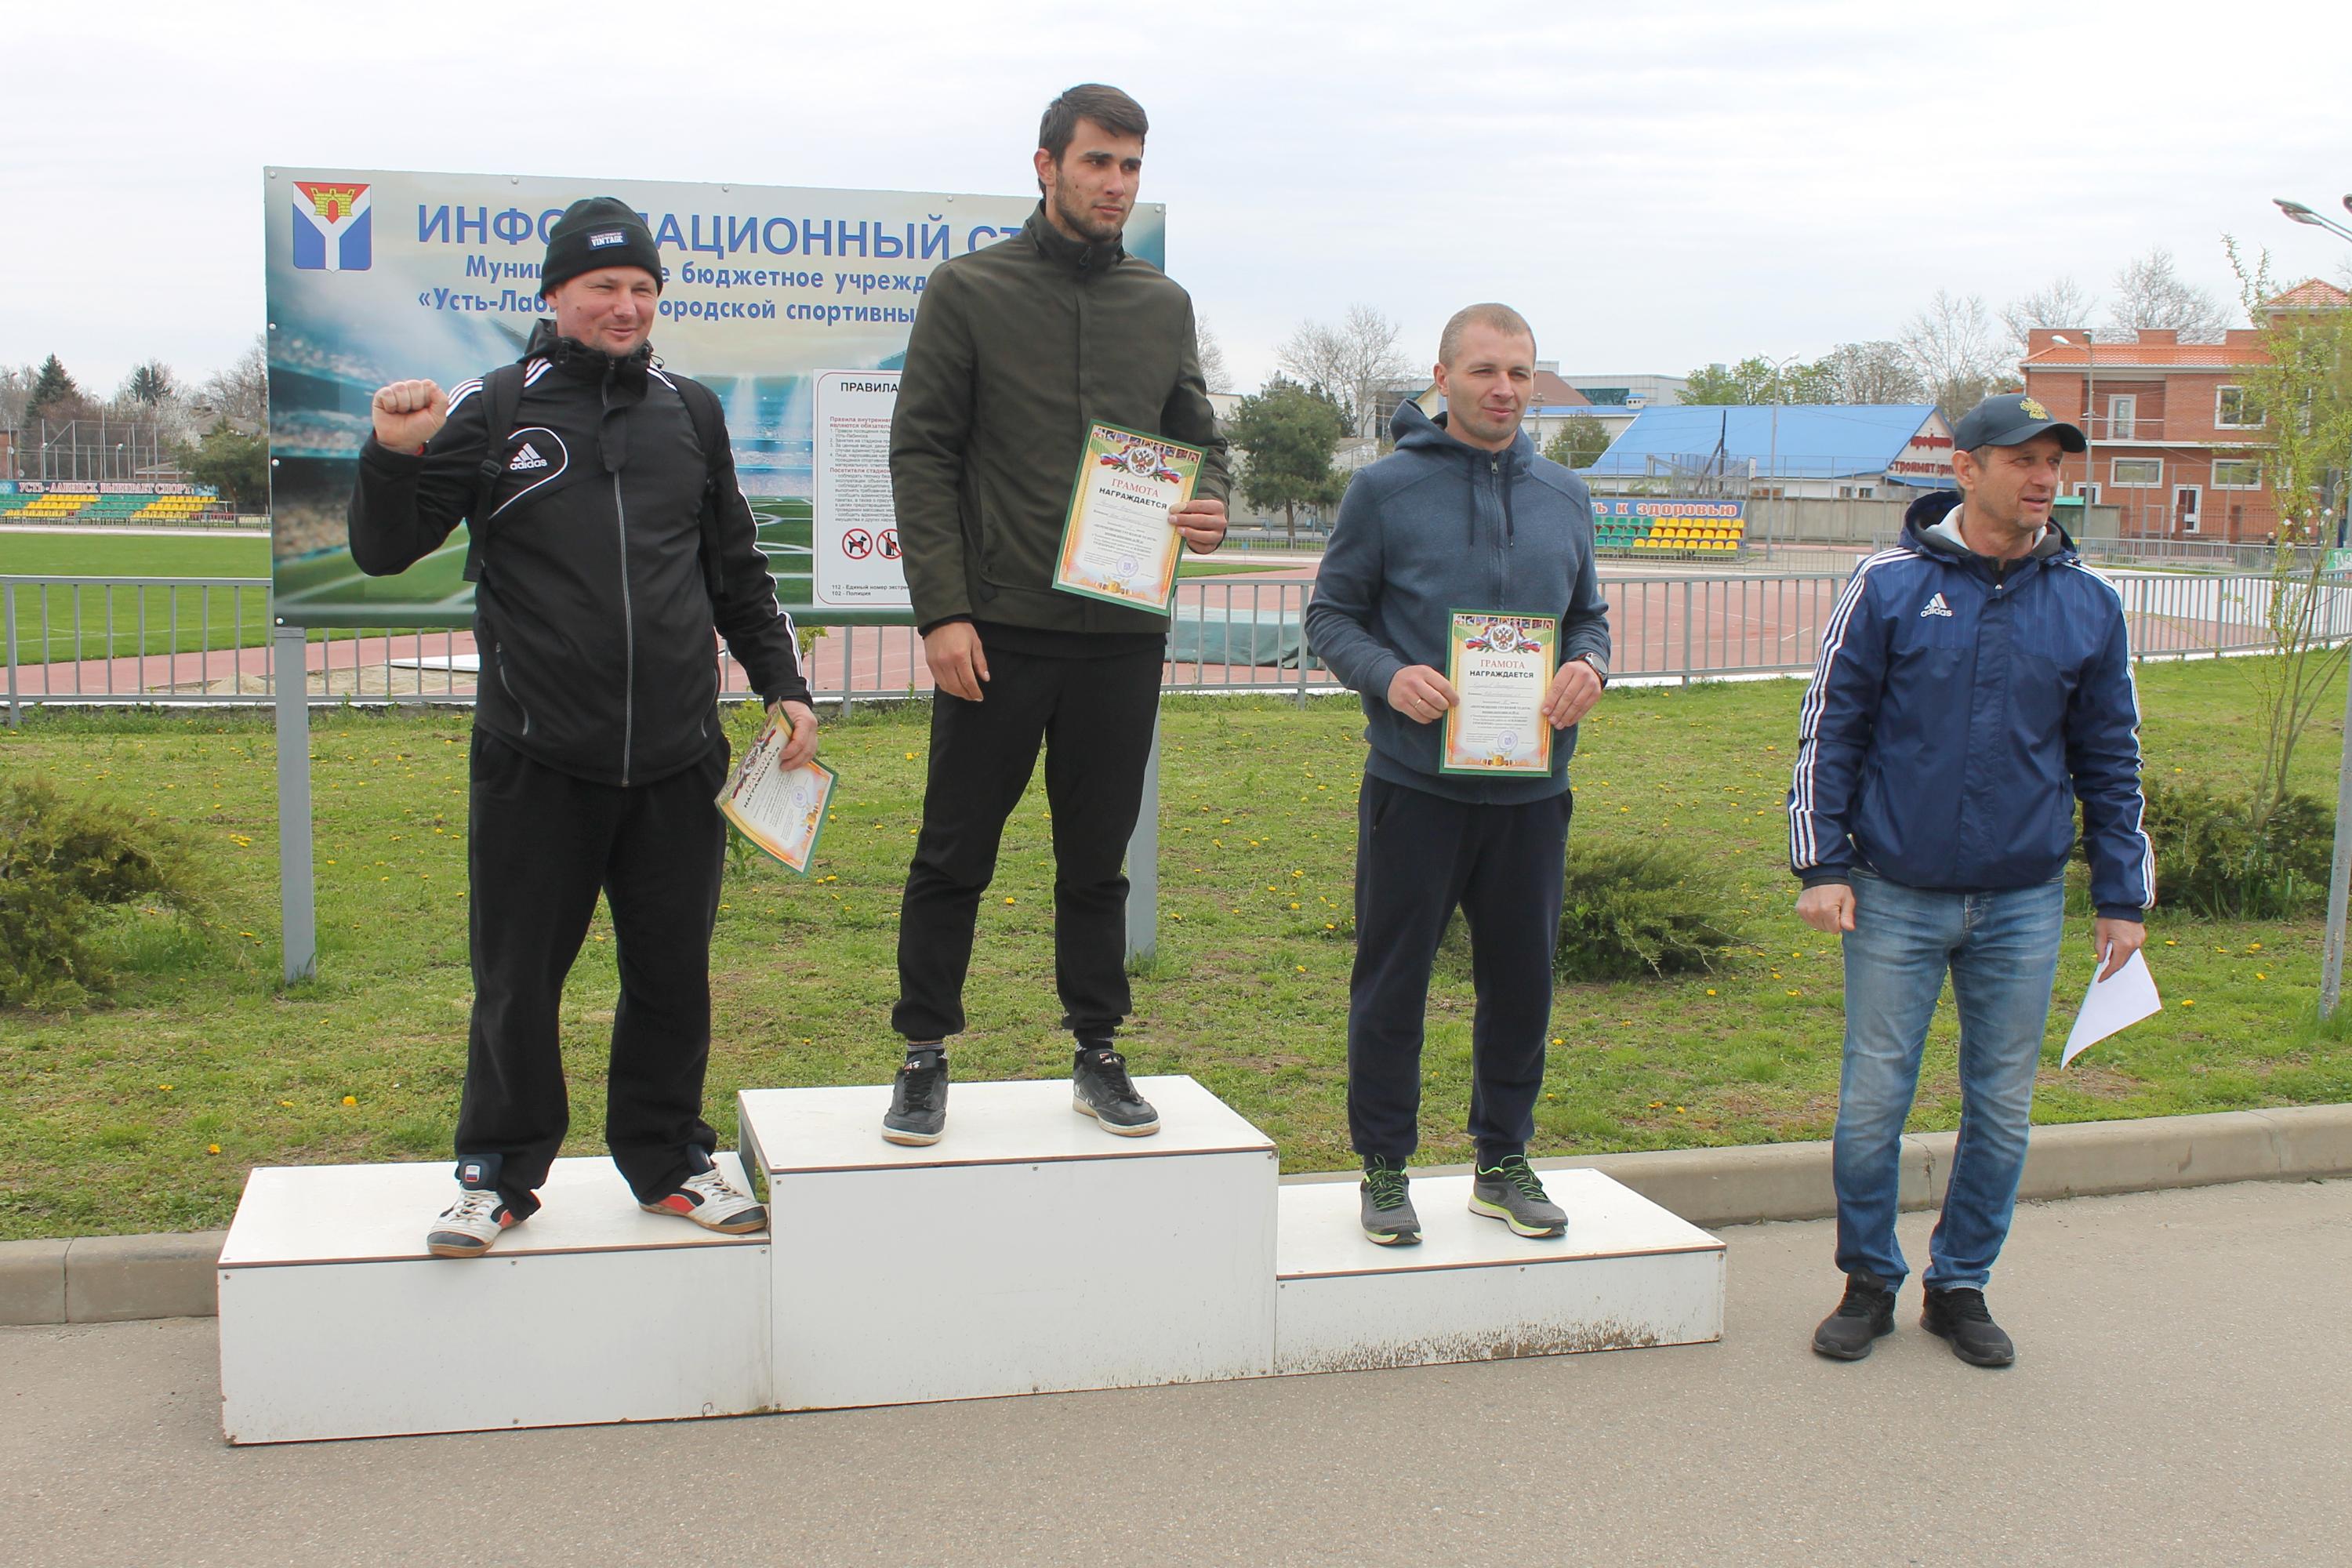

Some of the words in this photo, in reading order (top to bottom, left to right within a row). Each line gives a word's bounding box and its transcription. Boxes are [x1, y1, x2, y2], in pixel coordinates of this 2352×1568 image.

[419, 204, 949, 260] ИНФОАЦИОННЫЙ
[591, 235, 624, 247] VINTAGE
[682, 261, 824, 289] бюджетное
[835, 272, 927, 295] учрежд
[659, 299, 775, 322] ородской
[786, 303, 916, 326] спортивны
[840, 382, 898, 393] ПРАВИЛА
[510, 459, 548, 470] adidas
[1110, 477, 1160, 498] ГРАМОТА
[1098, 487, 1167, 510] НАГРАЖДАЕТСЯ
[1616, 503, 1628, 515] к
[1636, 503, 1737, 517] здоровью
[1920, 606, 1953, 617] adidas
[1480, 659, 1525, 670] ГРАМОТА
[1469, 670, 1534, 679] НАГРАЖДАЕТСЯ
